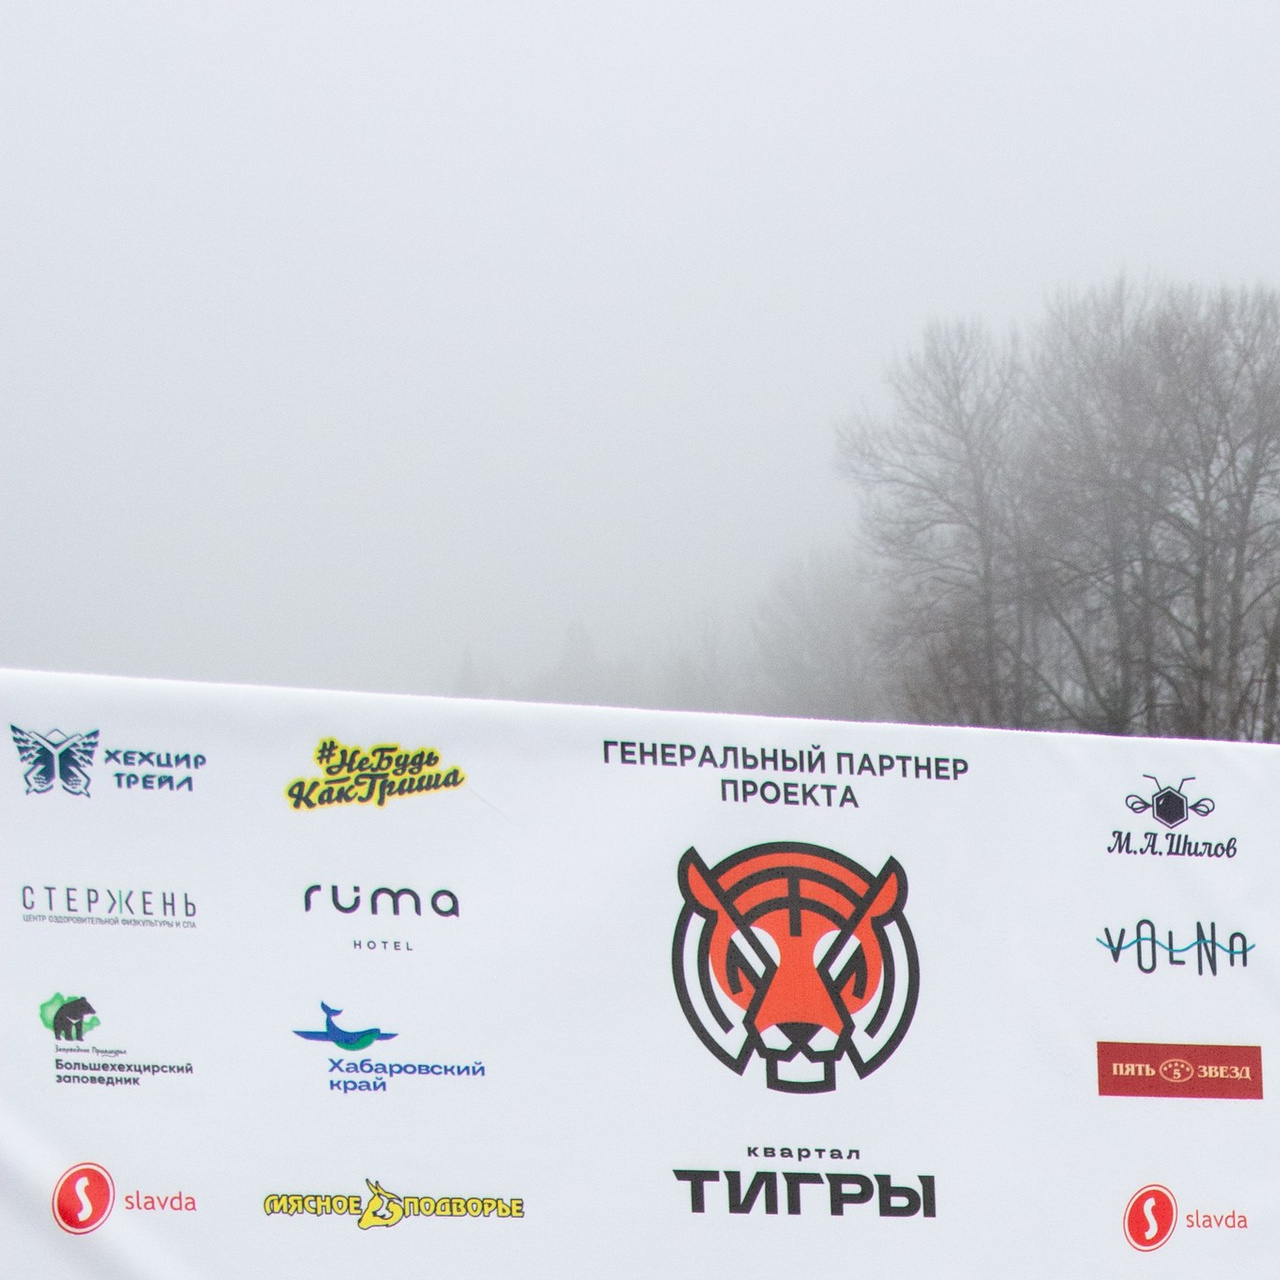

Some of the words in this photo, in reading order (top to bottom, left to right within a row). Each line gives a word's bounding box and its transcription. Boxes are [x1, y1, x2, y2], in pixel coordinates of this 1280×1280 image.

[104, 749, 206, 769] ХЕХЦИР
[603, 740, 827, 774] ГЕНЕРАЛЬНЫЙ
[836, 752, 969, 781] ПАРТНЕР
[721, 779, 859, 808] ПРОЕКТА
[22, 885, 196, 917] СТЕРЖЕНЬ
[23, 915, 47, 923] ЦЕНТР
[49, 916, 120, 926] ОЗДОРОВИТЕЛЬНОЙ
[354, 940, 413, 951] HOTEL
[1104, 919, 1247, 976] VOLNA
[55, 1059, 193, 1075] Большехехцирский
[329, 1059, 486, 1077] Хабаровский
[1112, 1063, 1156, 1076] ПЯТЬ
[1198, 1065, 1251, 1081] ЗВЕЗД
[56, 1074, 140, 1086] заповедник
[329, 1077, 387, 1094] край
[747, 1146, 861, 1161] квартал
[125, 1190, 197, 1211] slavda
[672, 1169, 936, 1218] ТИГРЫ
[264, 1194, 362, 1216] МЯСНОЕ
[403, 1196, 524, 1218] ПОДВОРЬЕ
[1186, 1209, 1248, 1229] slavda
